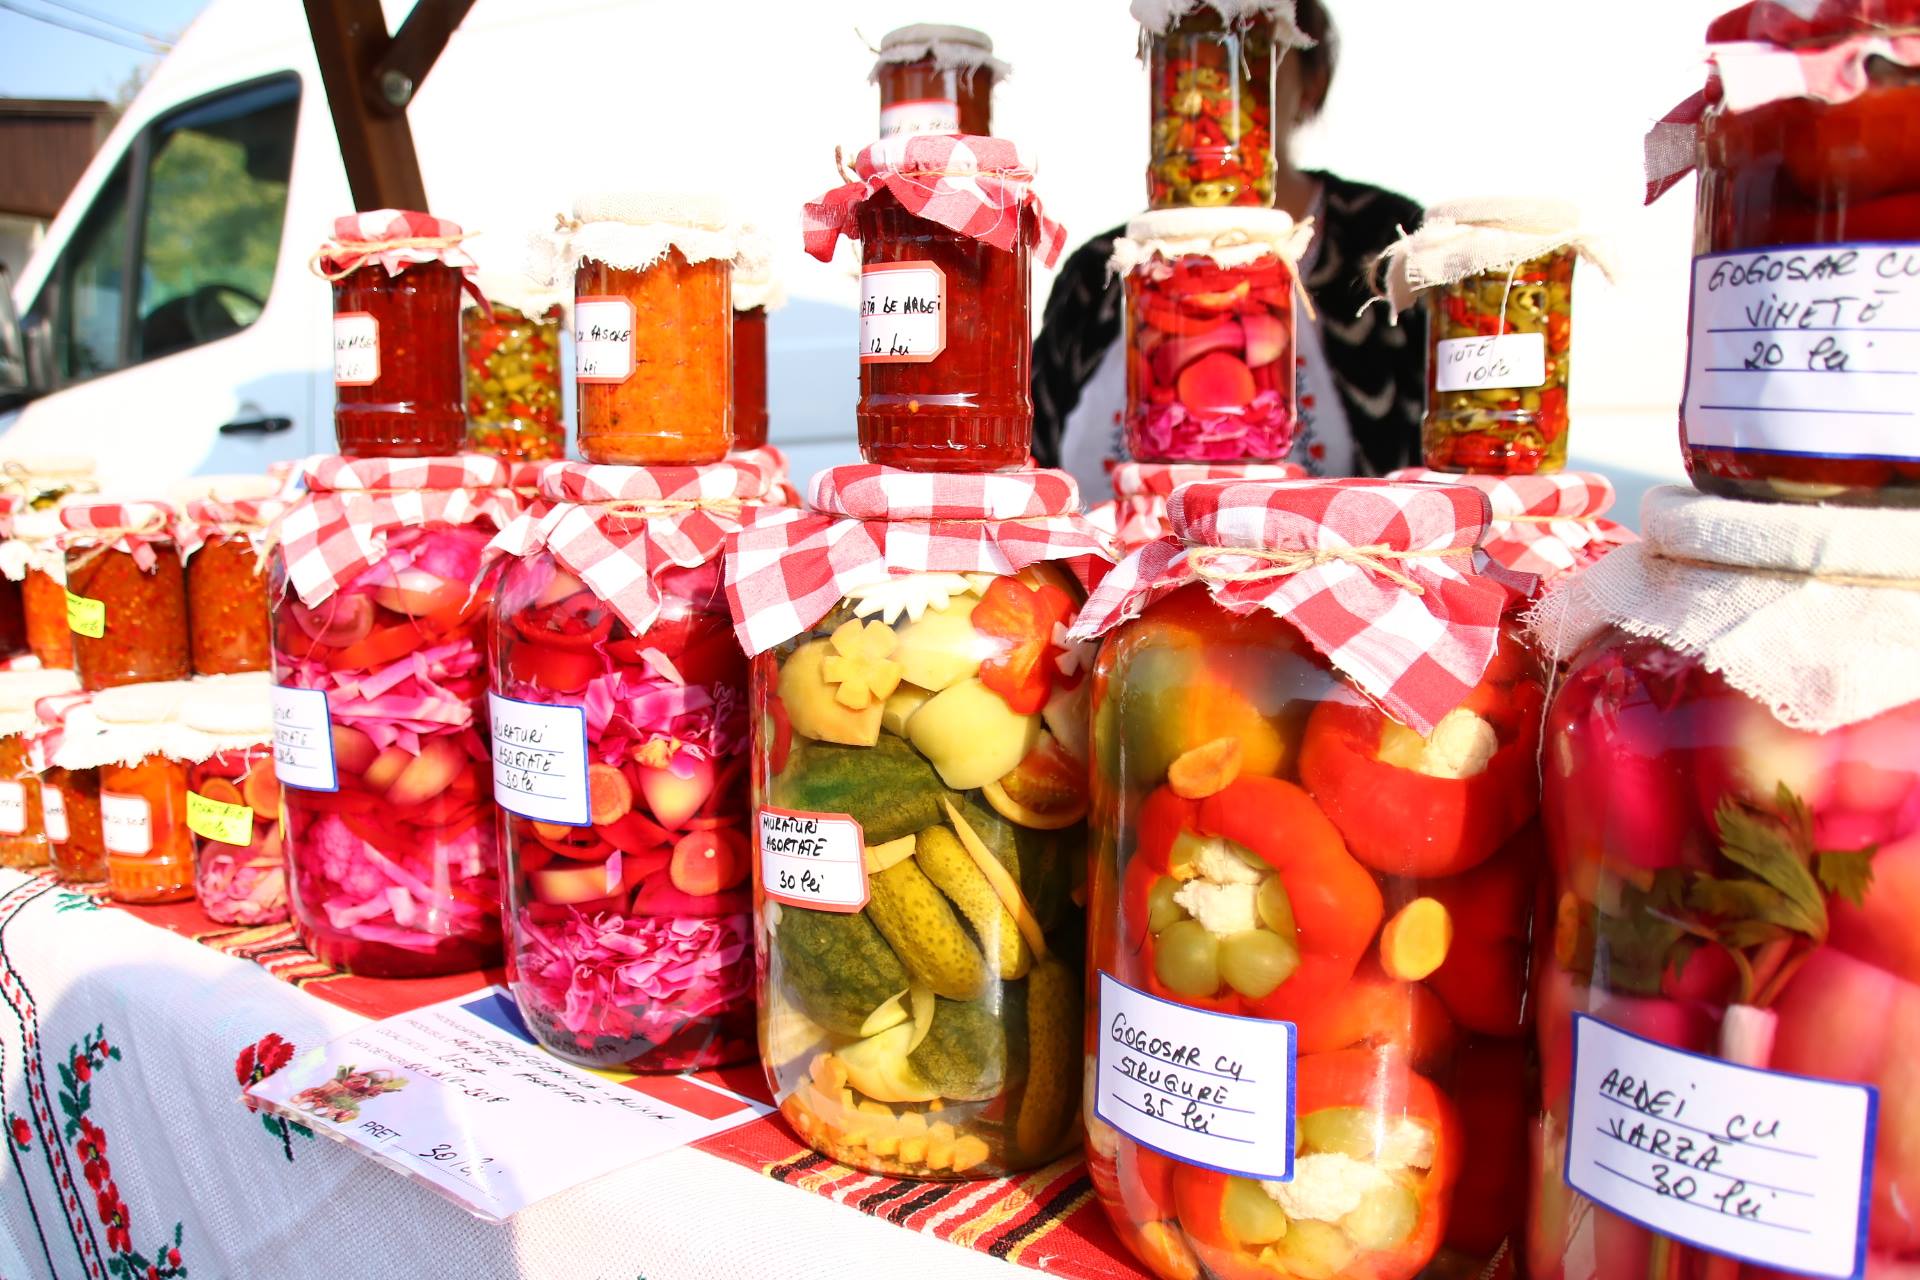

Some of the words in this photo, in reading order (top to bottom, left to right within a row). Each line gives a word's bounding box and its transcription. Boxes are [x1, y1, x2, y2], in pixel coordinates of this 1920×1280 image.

[1708, 251, 1858, 292] GOGOSAR
[1744, 341, 1784, 370] 20
[779, 870, 795, 889] 30
[1111, 1012, 1201, 1067] GOGOSAR
[1214, 1056, 1243, 1081] CU
[1121, 1056, 1230, 1105] STRUGURE
[1600, 1067, 1696, 1117] ARDEI
[1143, 1092, 1174, 1117] 35
[1181, 1101, 1215, 1134] lei
[419, 1144, 457, 1160] 30
[1651, 1164, 1697, 1201] 30
